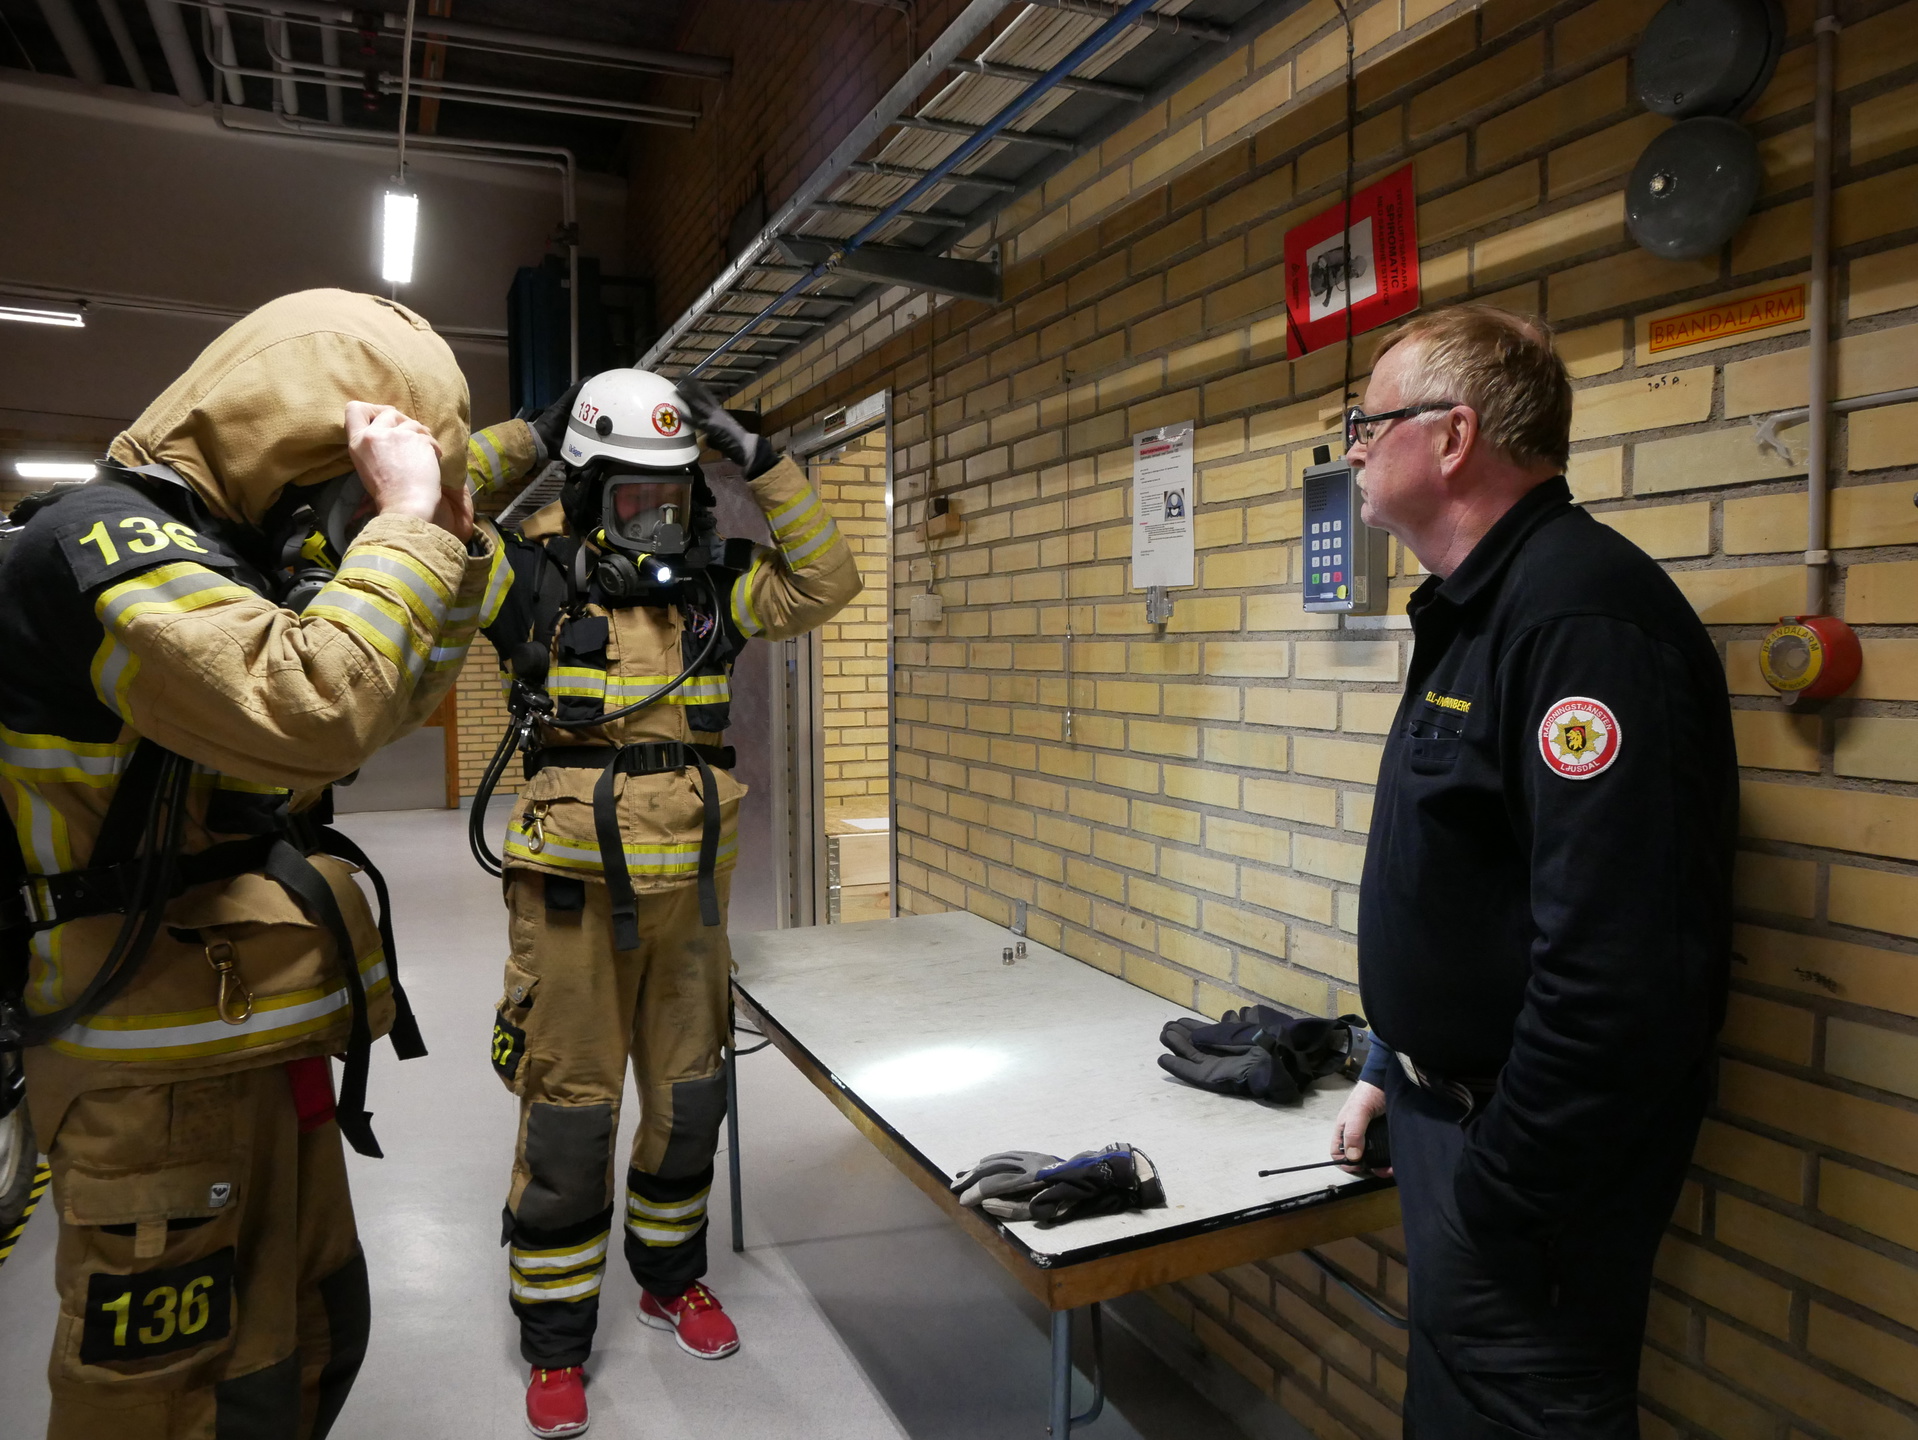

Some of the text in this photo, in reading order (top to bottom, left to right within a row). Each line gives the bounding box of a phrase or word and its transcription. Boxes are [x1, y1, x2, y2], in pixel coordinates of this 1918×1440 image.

[1386, 203, 1400, 289] SPIROMATIC
[1654, 297, 1796, 345] BRANDALARM
[578, 401, 599, 424] 137
[78, 516, 209, 566] 136
[1762, 627, 1819, 653] BRANDALARM
[1543, 703, 1612, 738] RÄDDNINGSTJÄNSTEN
[1560, 760, 1600, 773] LJUSDAL
[492, 1025, 514, 1066] 37
[102, 1275, 214, 1346] 136
